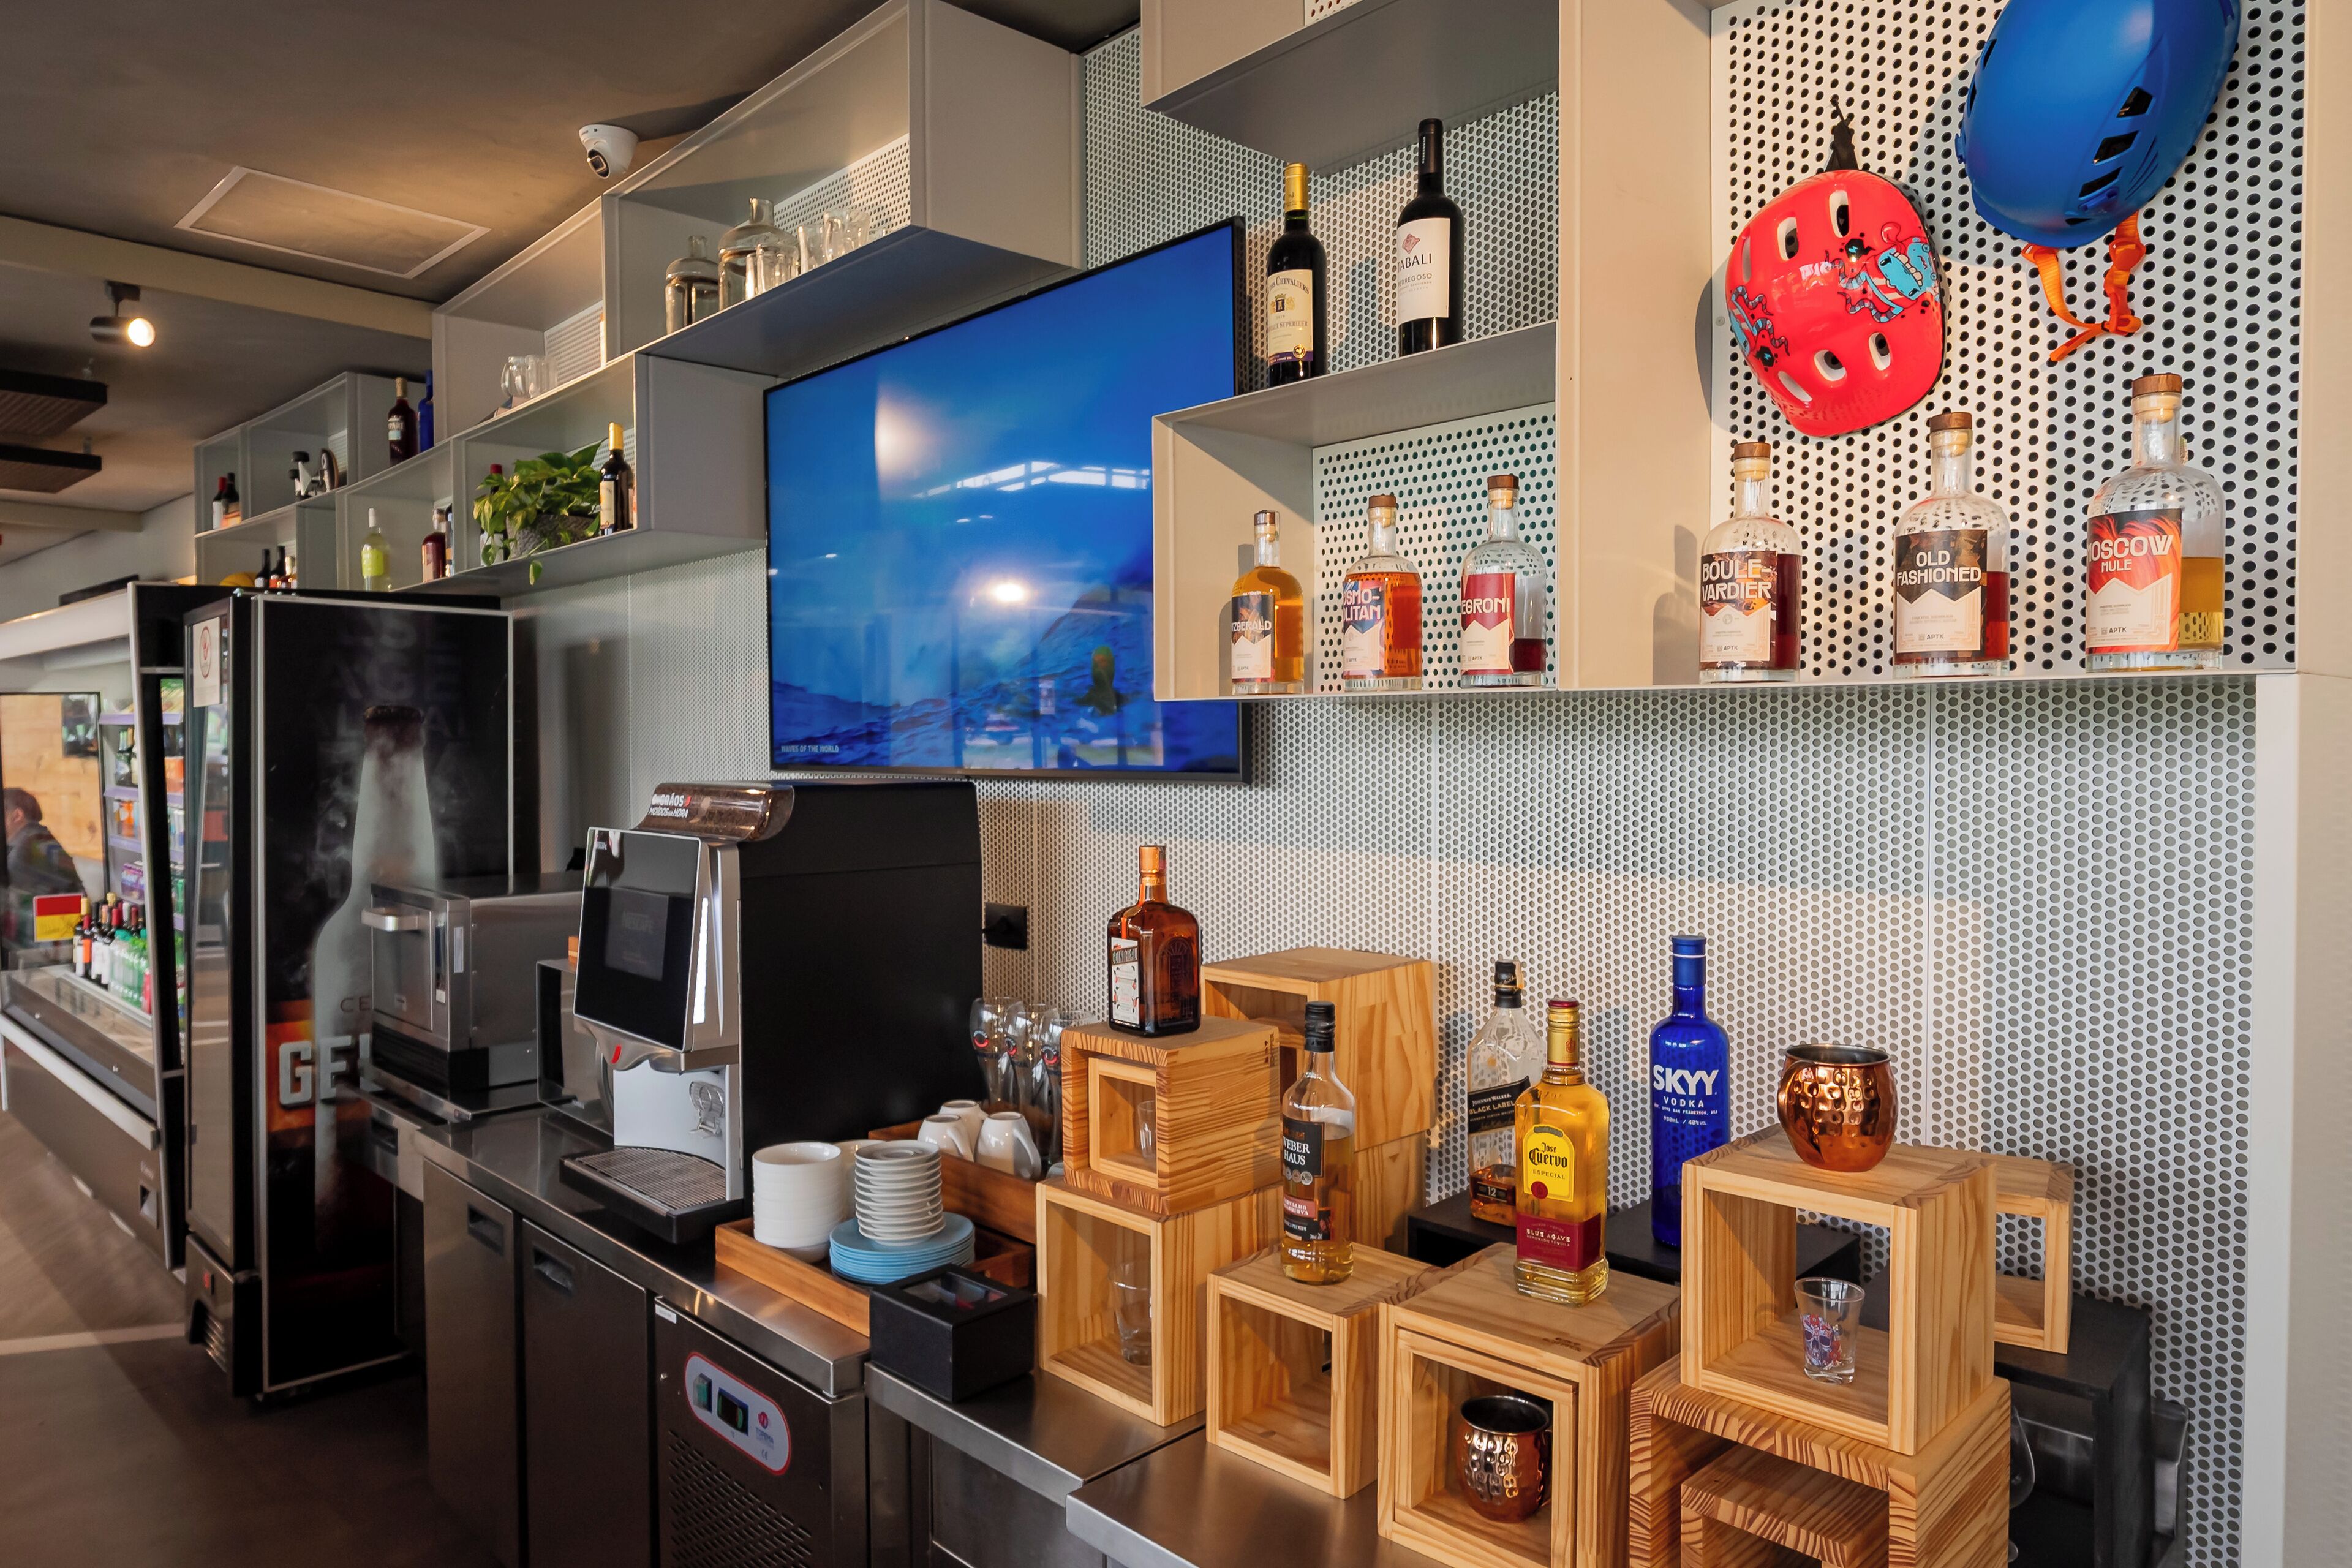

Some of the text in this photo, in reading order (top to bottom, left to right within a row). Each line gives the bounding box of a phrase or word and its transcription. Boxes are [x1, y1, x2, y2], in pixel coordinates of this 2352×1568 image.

[1916, 550, 1950, 567] OLD
[2101, 559, 2132, 573] MULE
[1702, 559, 1772, 582] BOULE-
[1896, 567, 1982, 587] FASHIONED
[1702, 582, 1773, 601] VARDIER
[673, 808, 688, 818] HORA
[1653, 1065, 1719, 1096] SKYY
[1469, 1100, 1515, 1115] BLACK LABEL
[1664, 1096, 1704, 1108] VODKA
[1283, 1136, 1310, 1155] WEBER
[1541, 1142, 1557, 1153] Jose
[1284, 1149, 1306, 1166] HAUS
[1529, 1147, 1567, 1169] Cuervo
[1533, 1169, 1566, 1180] ESPECIAL
[1487, 1186, 1497, 1197] 12
[1526, 1228, 1544, 1238] BLUE
[1546, 1233, 1570, 1243] AGAVE
